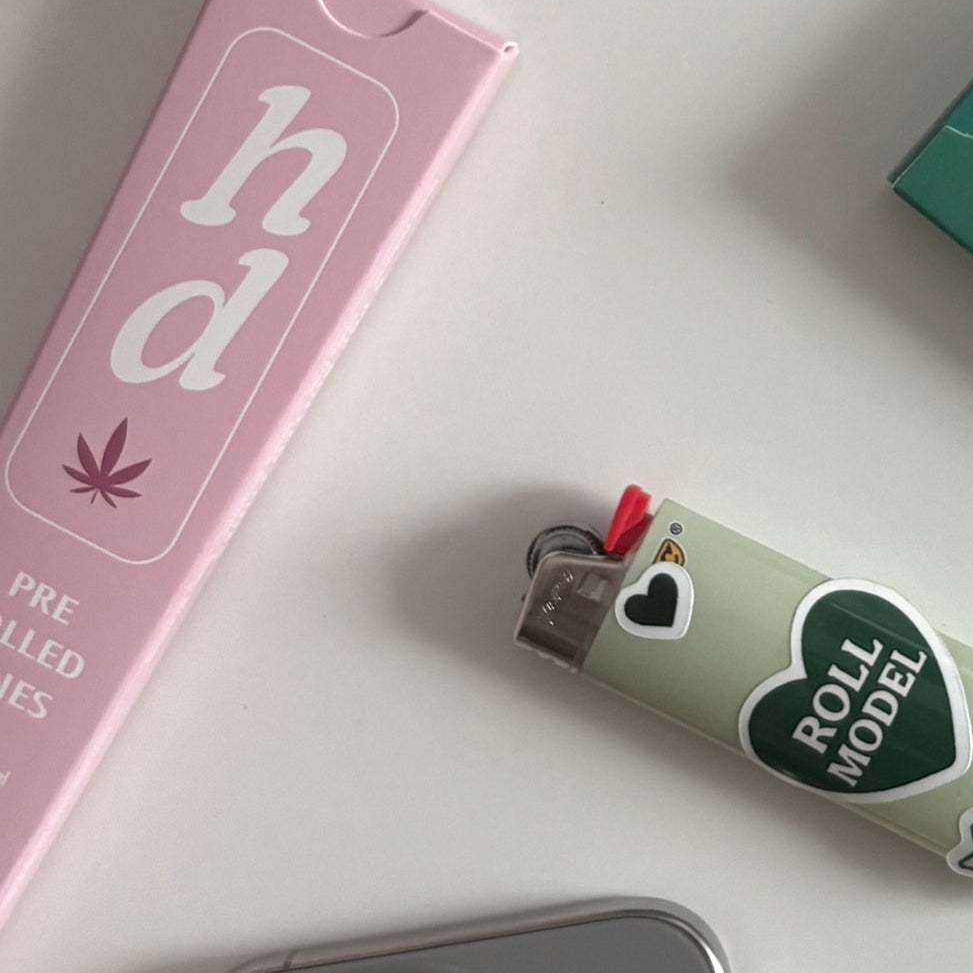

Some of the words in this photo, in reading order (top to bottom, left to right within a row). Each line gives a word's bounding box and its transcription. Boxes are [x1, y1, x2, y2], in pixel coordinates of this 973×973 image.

[180, 85, 348, 236] h
[110, 248, 290, 392] d
[7, 570, 80, 626] PRE
[791, 638, 884, 755] ROLL
[826, 649, 928, 788] MODEL
